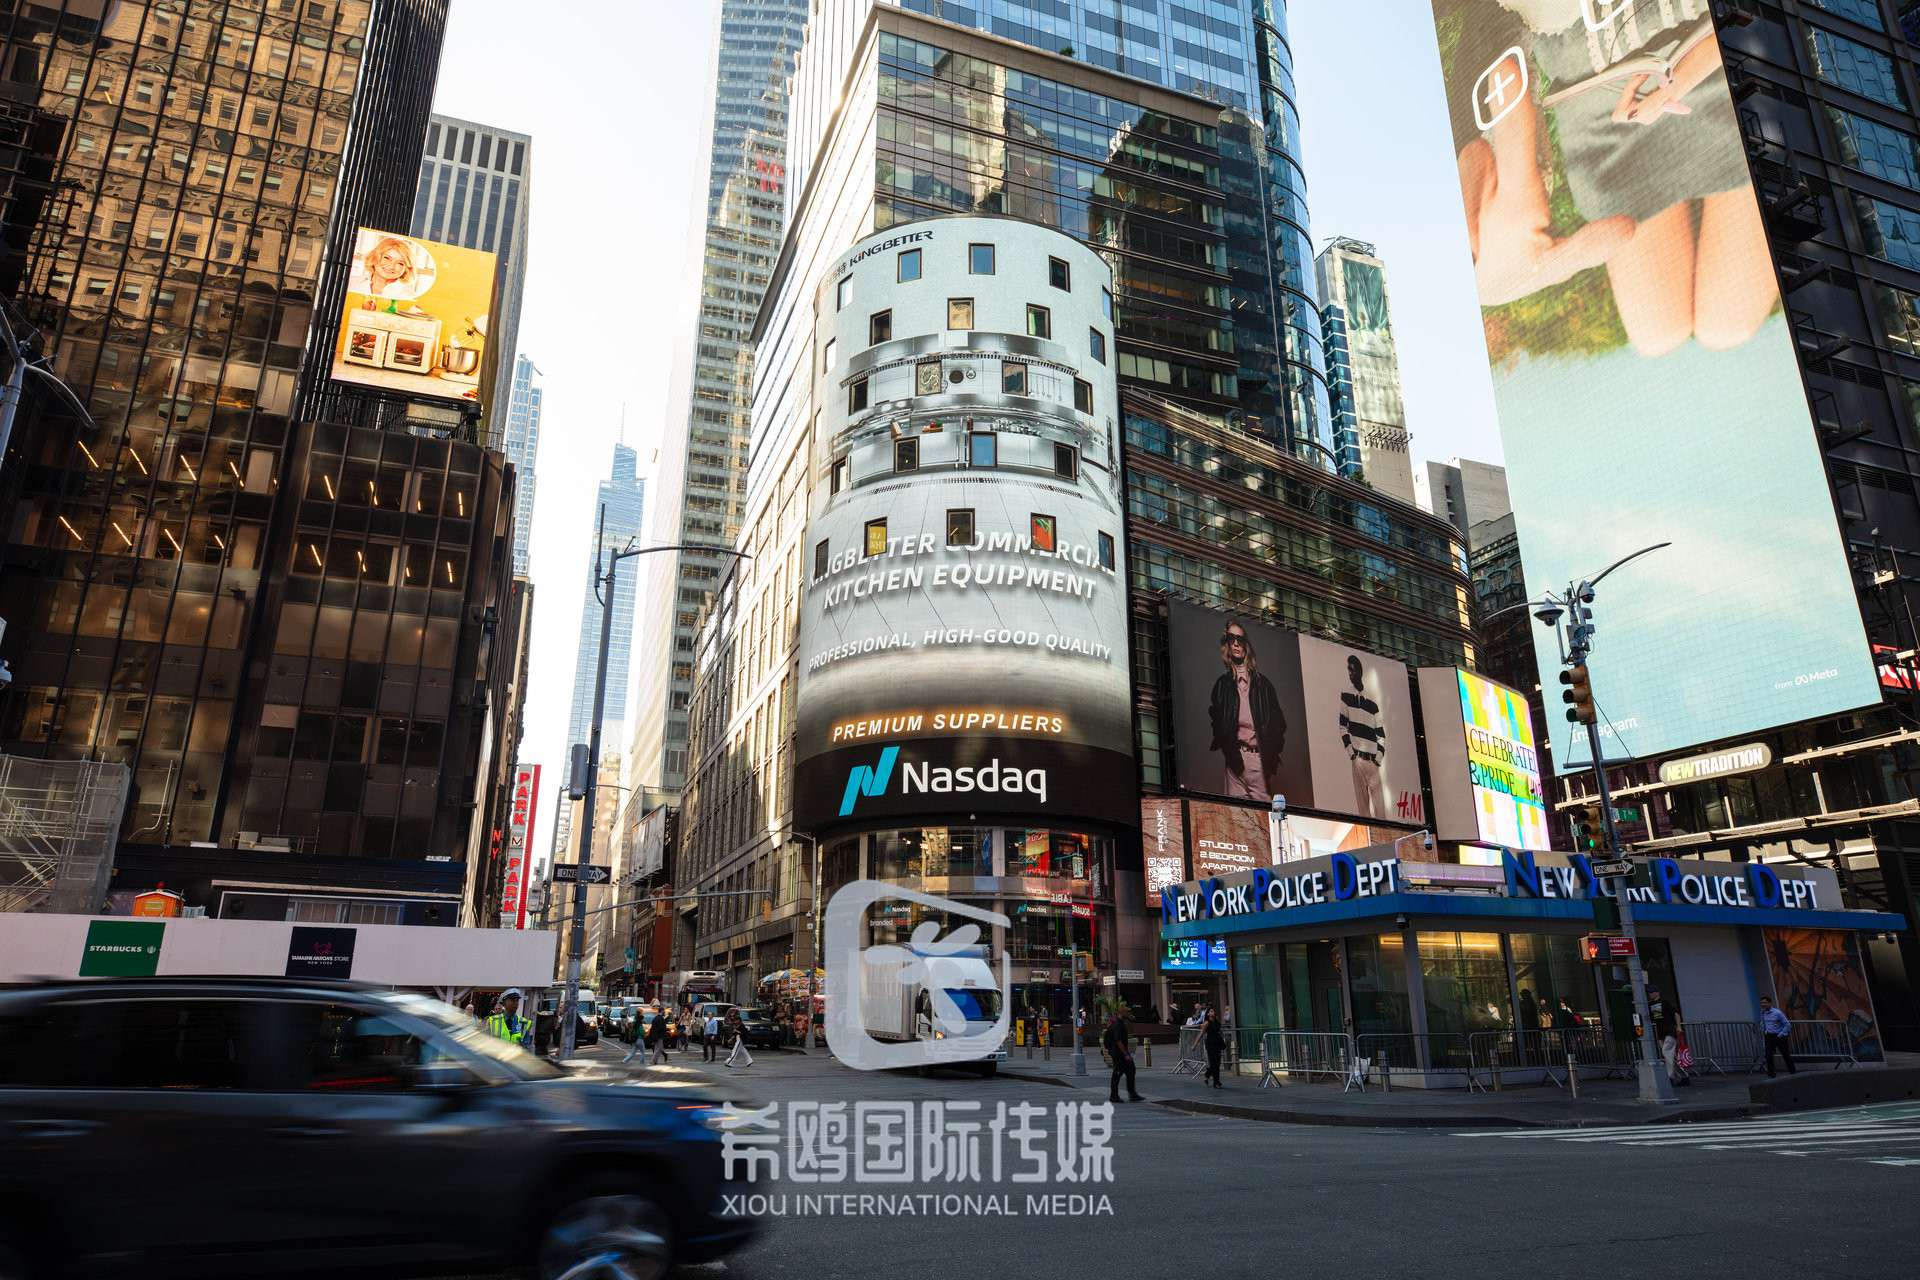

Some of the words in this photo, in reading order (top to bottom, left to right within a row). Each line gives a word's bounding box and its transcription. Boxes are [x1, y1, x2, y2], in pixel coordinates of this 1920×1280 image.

[823, 566, 923, 609] KITCHEN
[932, 563, 1097, 599] EQUIPMENT
[808, 632, 916, 672] PROFESSIONAL,
[923, 629, 1040, 646] HIGH-GOOD
[1045, 634, 1111, 660] QUALITY
[1774, 680, 1793, 690] from
[1808, 668, 1838, 682] Meta
[833, 715, 923, 742] PREMIUM
[933, 713, 1063, 733] SUPPLIERS
[1572, 717, 1638, 743] Insagram
[514, 773, 530, 825] PARK
[902, 759, 1047, 803] Nasdaq
[1397, 791, 1422, 822] H&M
[1157, 809, 1165, 852] FRANK
[1199, 840, 1234, 850] STUDIO
[1235, 844, 1249, 852] TO
[562, 870, 578, 878] ONE
[1208, 852, 1255, 863] BEDROOM
[1614, 864, 1628, 872] WAY
[504, 857, 521, 912] PARK
[1161, 885, 1200, 924] NEW
[1199, 878, 1250, 918] YORK
[1253, 868, 1326, 911] POLICE
[1331, 853, 1398, 901] DEPT
[1503, 849, 1575, 899] NEW
[1656, 858, 1749, 907] POLICE
[1750, 864, 1817, 909] DEPT
